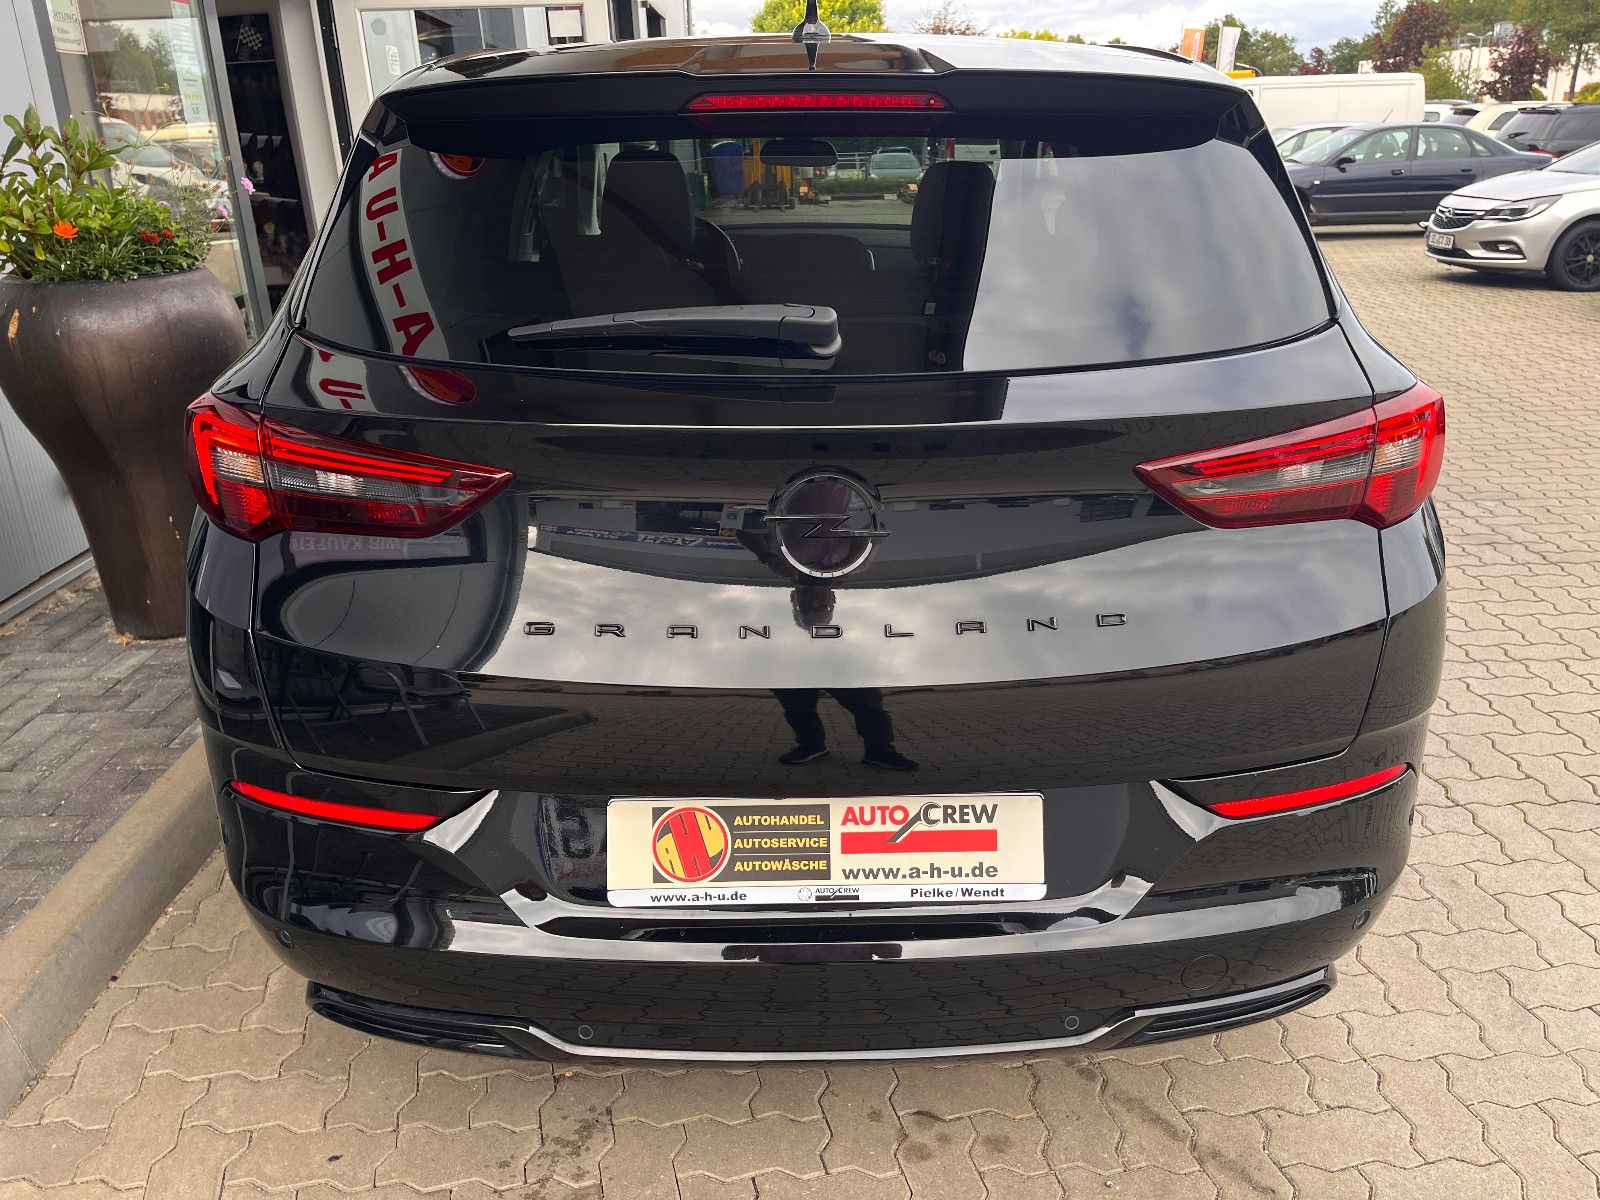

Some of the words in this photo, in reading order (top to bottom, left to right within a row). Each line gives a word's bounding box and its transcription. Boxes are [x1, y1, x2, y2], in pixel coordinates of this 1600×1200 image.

[523, 612, 1128, 640] GRANDLAND
[733, 814, 825, 827] AUTOHANDEL
[733, 837, 828, 849] AUTOSERVICE
[733, 859, 828, 872] AUTOWÄSCHE
[842, 861, 999, 880] www.a-h-u.de
[650, 891, 748, 904] www.a-h-u.de
